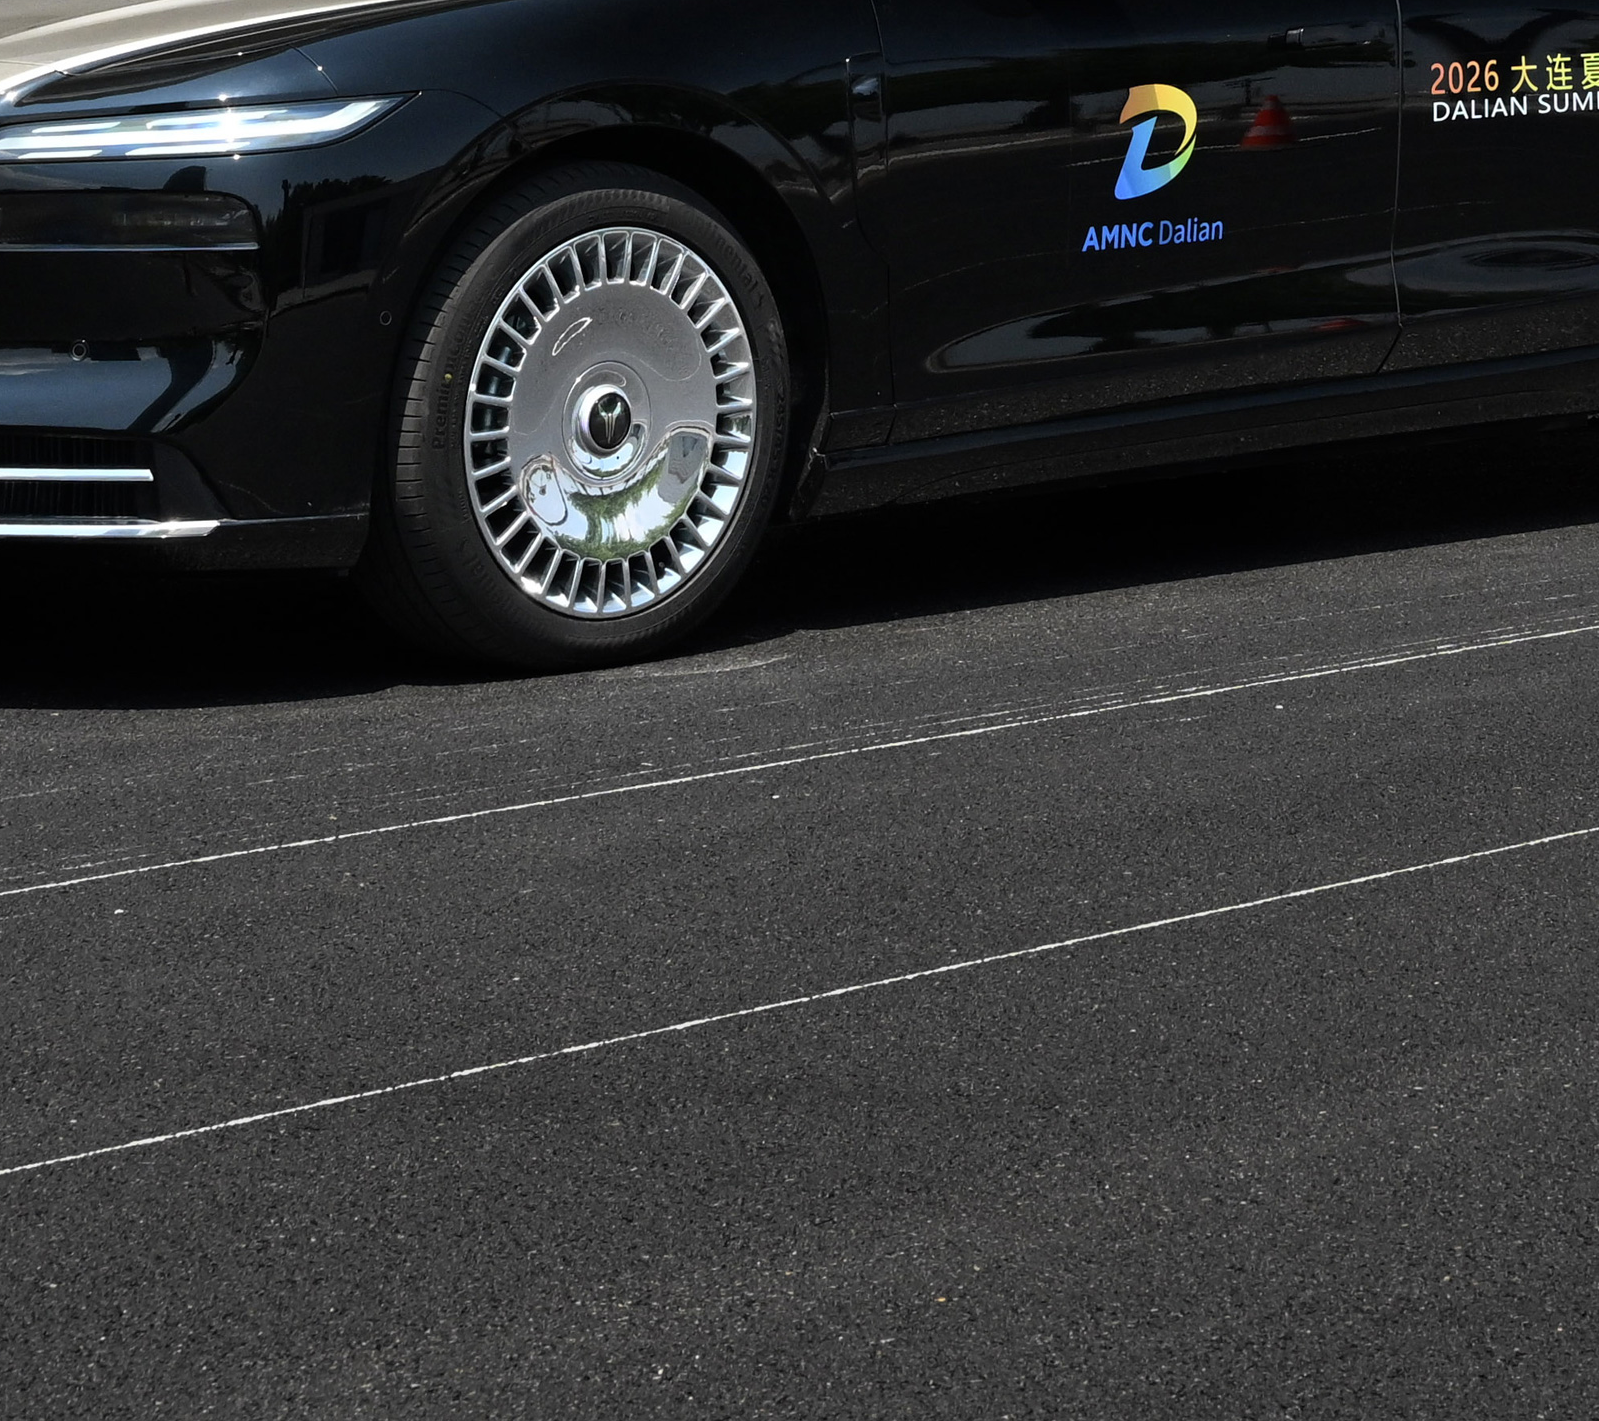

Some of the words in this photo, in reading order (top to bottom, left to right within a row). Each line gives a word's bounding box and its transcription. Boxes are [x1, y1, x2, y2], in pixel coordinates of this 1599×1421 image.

[1430, 59, 1499, 95] 2026
[1433, 96, 1528, 122] DALIAN
[1082, 221, 1154, 252] AMNC
[1158, 217, 1223, 246] Dalian
